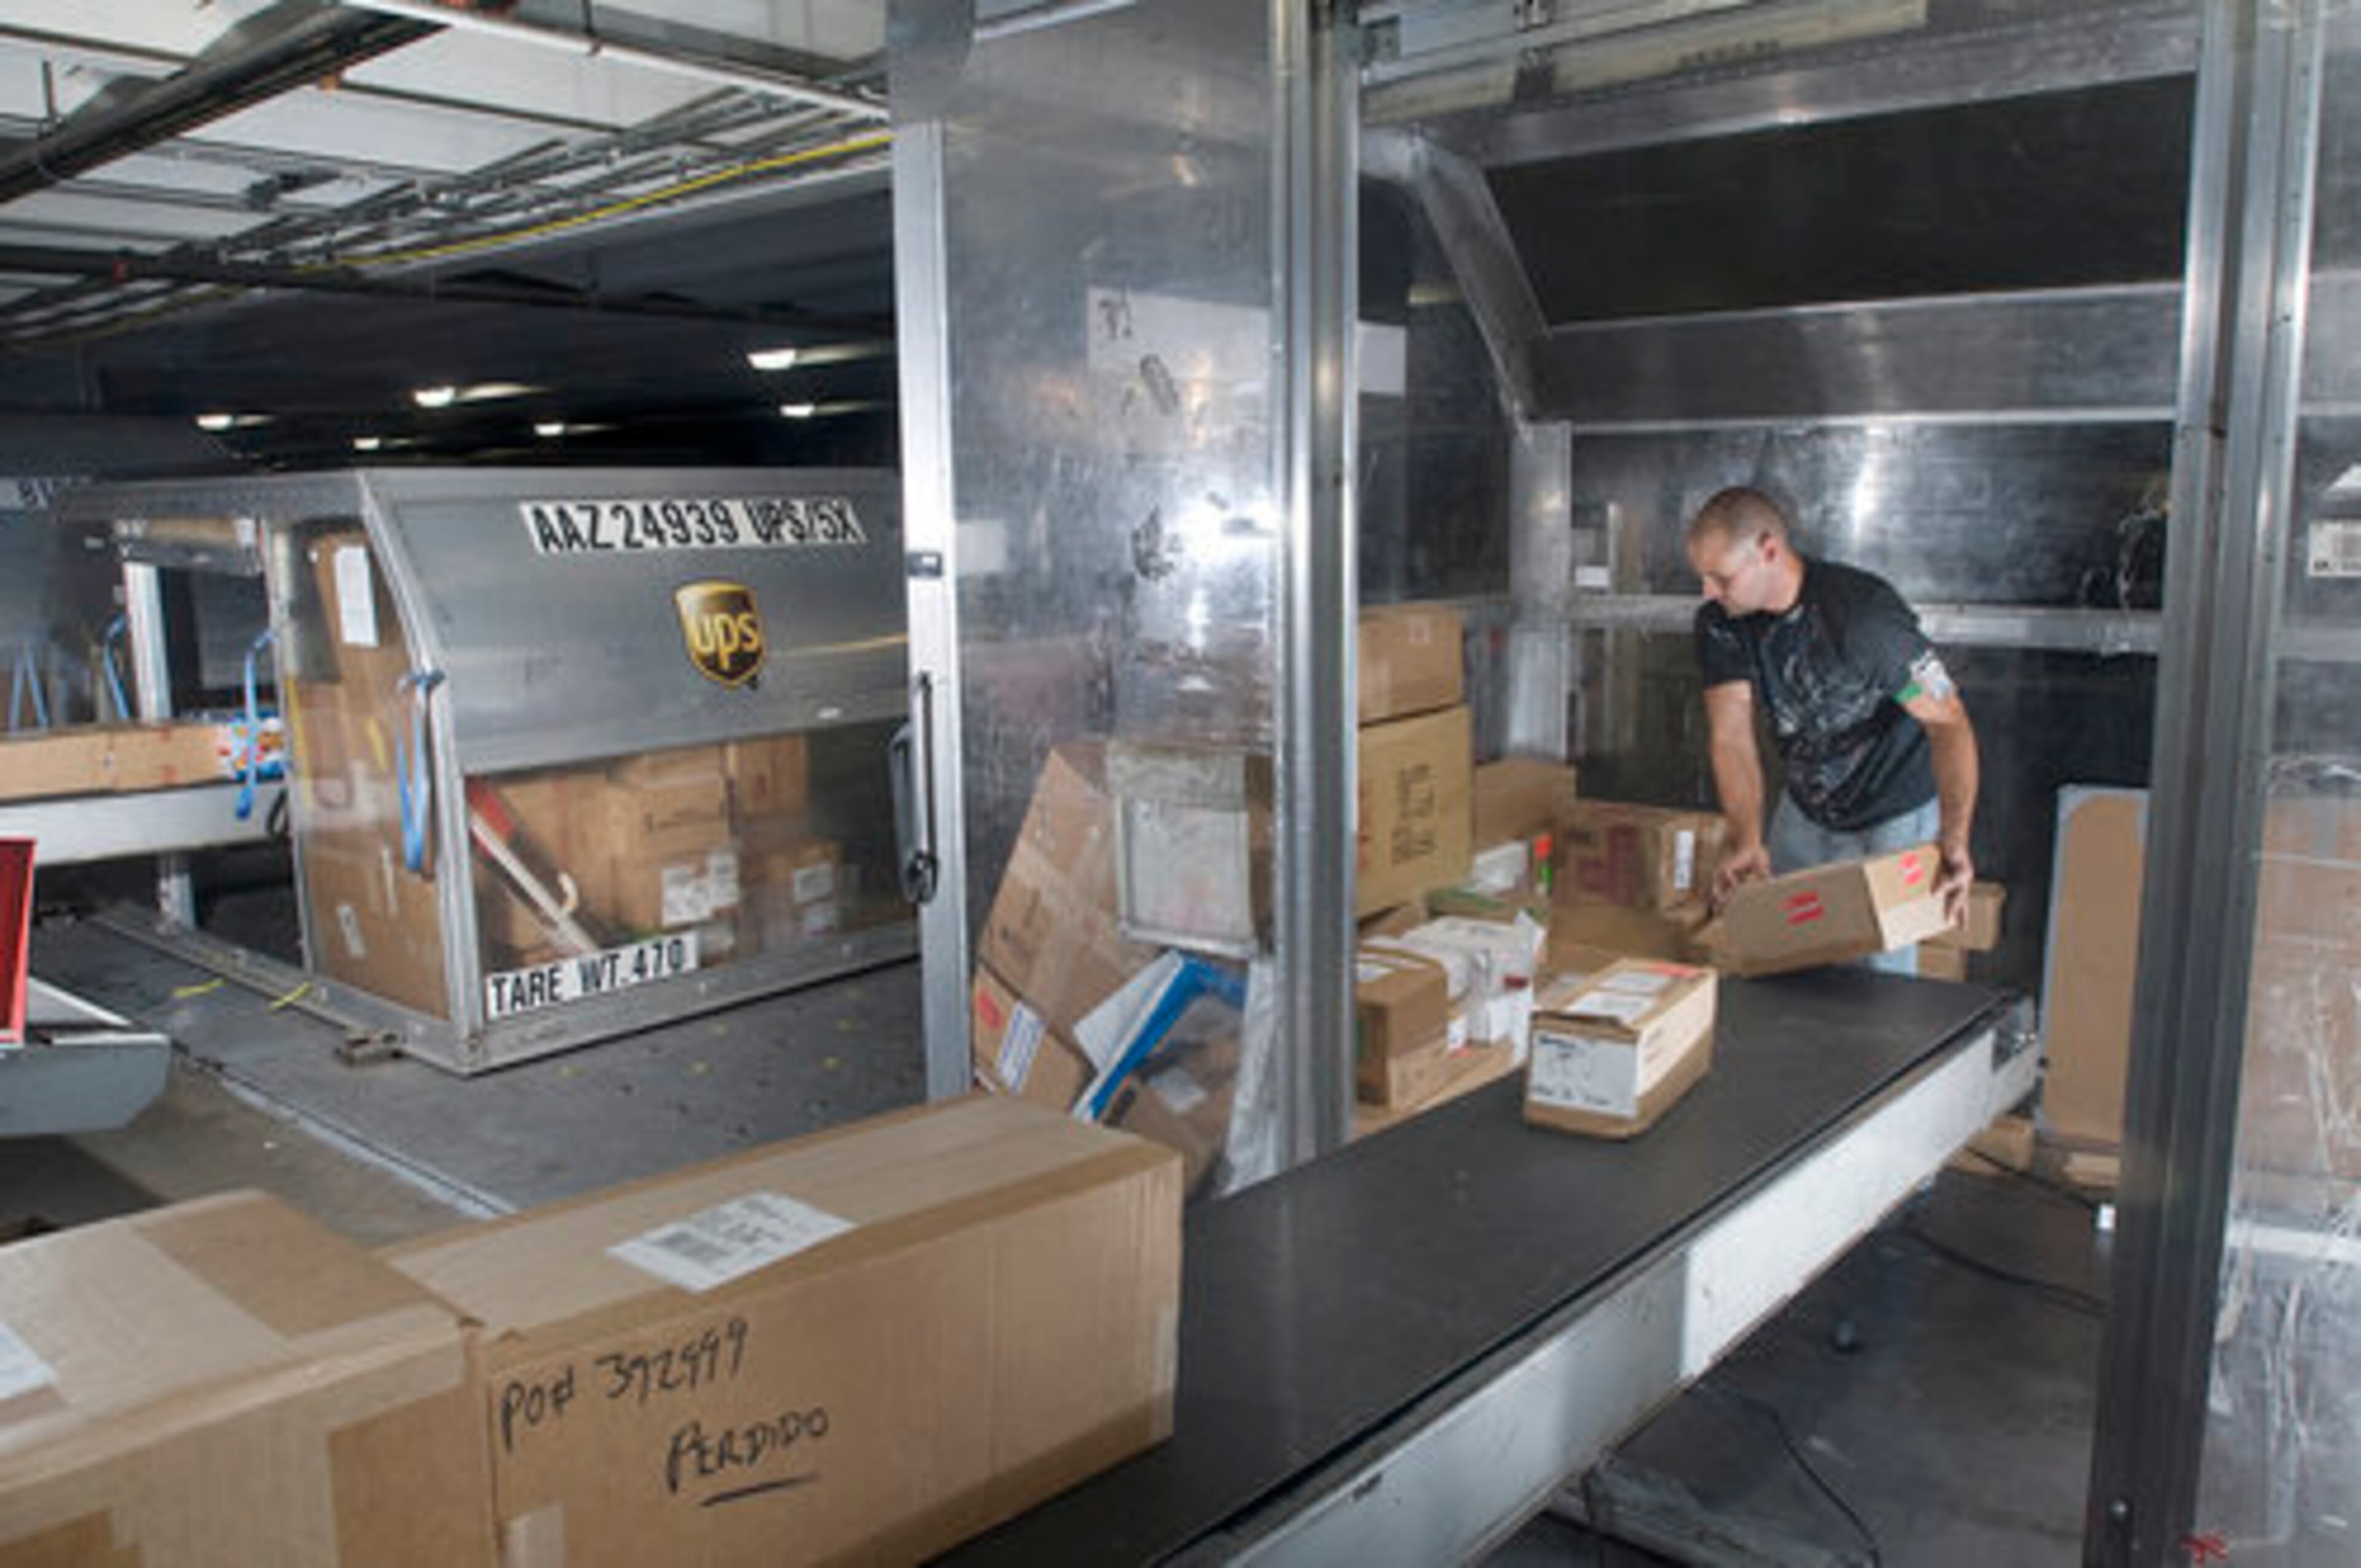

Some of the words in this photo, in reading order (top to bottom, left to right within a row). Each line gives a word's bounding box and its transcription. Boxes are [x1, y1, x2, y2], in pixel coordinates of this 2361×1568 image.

[492, 967, 561, 1012] TARE
[502, 1364, 575, 1454] PO#
[666, 1408, 829, 1494] PERDIDO
